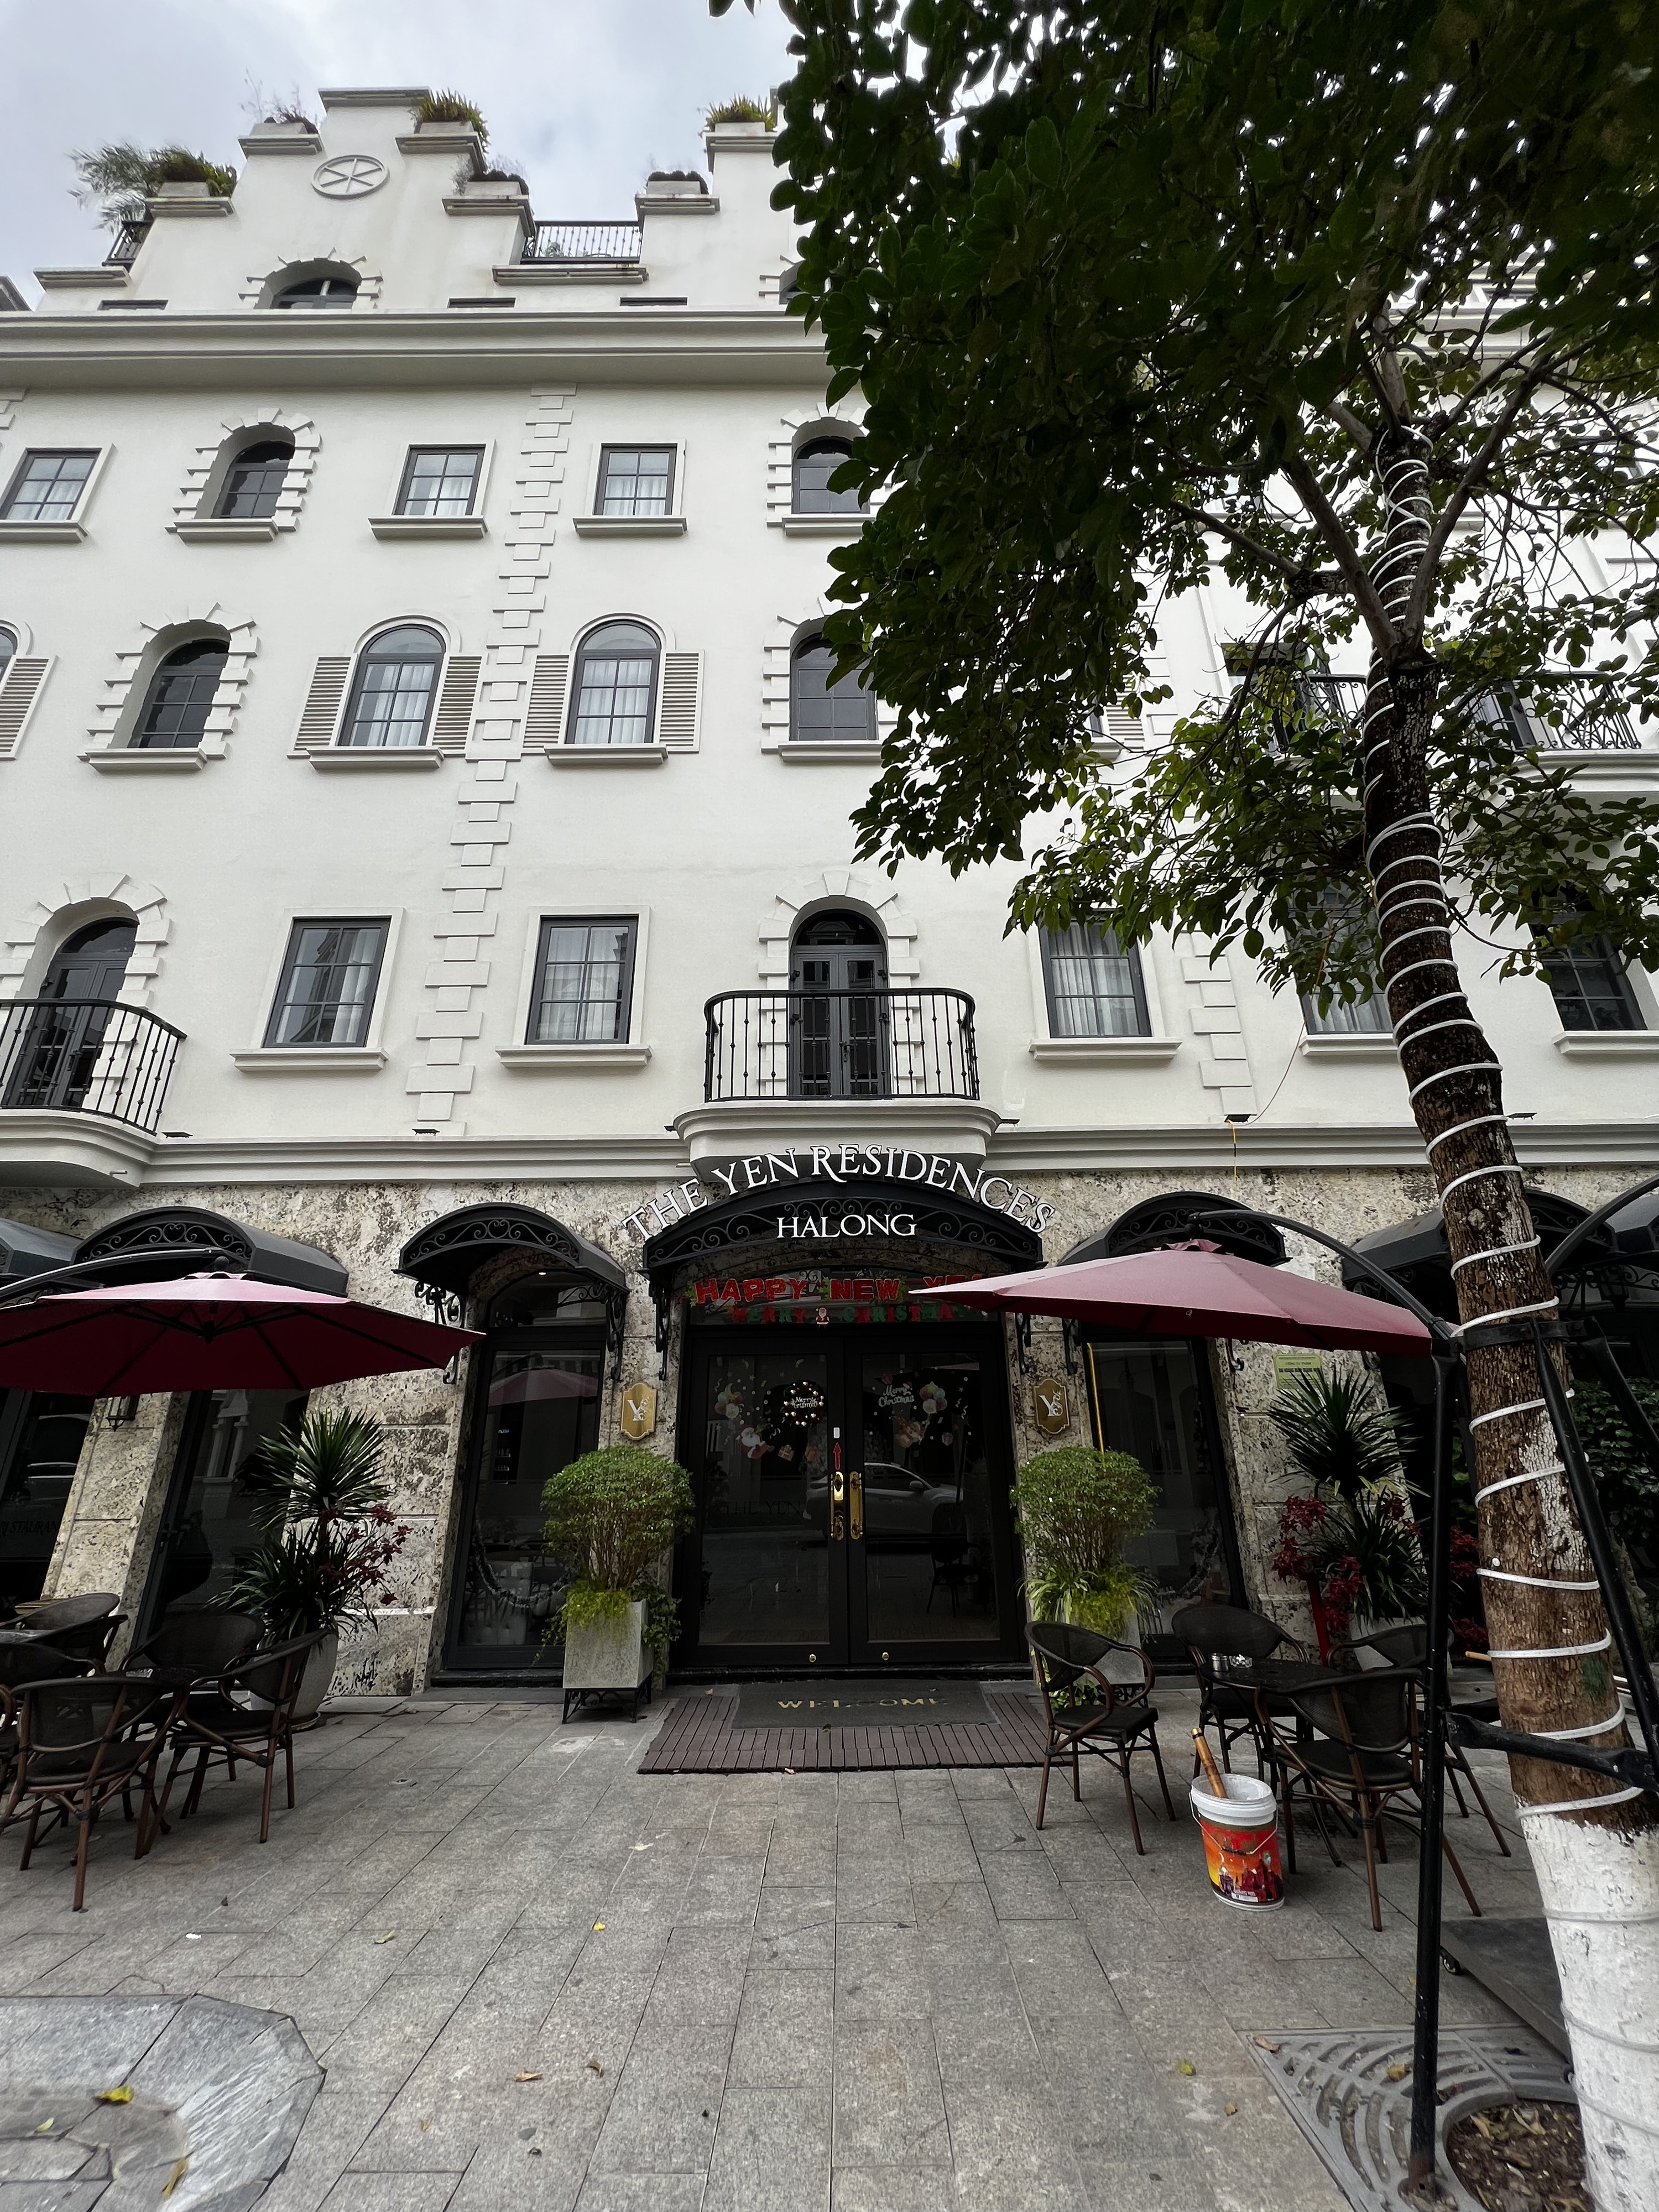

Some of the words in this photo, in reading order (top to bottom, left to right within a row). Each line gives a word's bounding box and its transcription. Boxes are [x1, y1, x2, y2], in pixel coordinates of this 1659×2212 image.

[623, 1178, 708, 1241] THE
[712, 1148, 799, 1196] YEN
[811, 1144, 1055, 1235] RESIDENCES
[776, 1213, 916, 1239] HALONG
[695, 1277, 810, 1304] HAPPY
[829, 1278, 901, 1301] NEW
